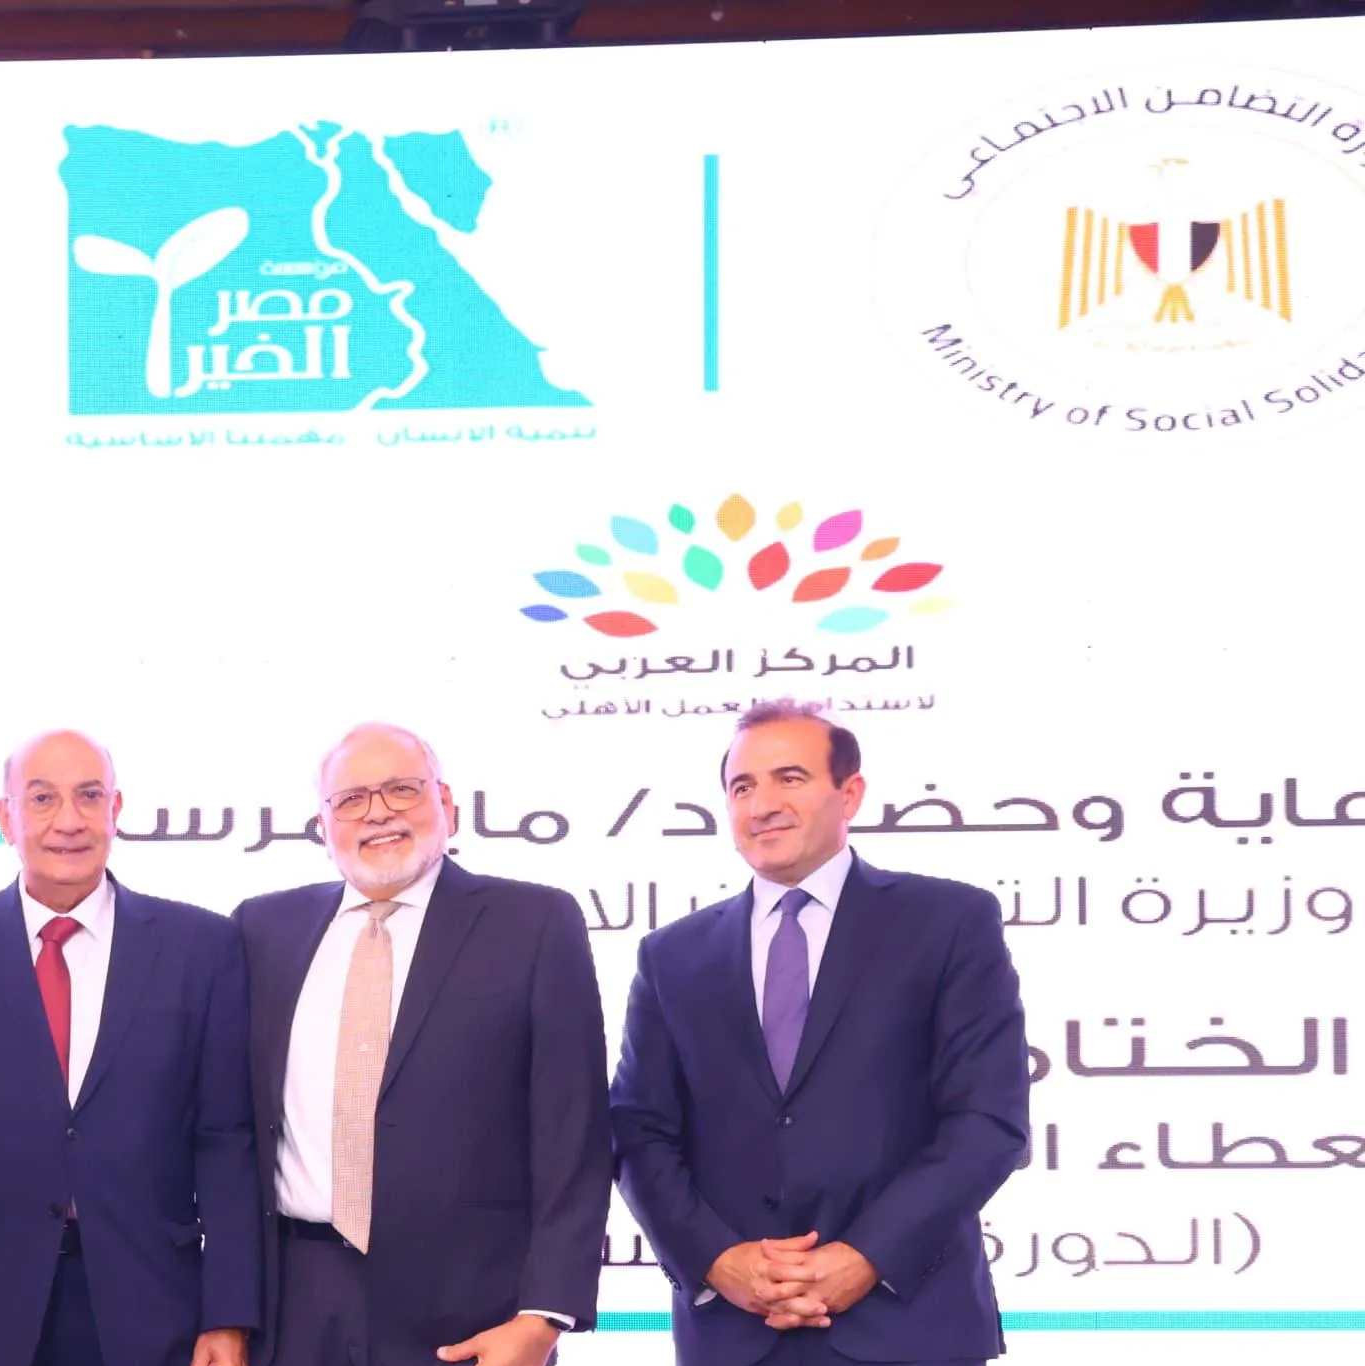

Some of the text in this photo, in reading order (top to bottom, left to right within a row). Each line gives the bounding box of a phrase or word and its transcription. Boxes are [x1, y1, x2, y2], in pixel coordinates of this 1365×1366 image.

[1145, 85, 1332, 126] التضامن
[208, 288, 353, 336] مصر
[173, 324, 352, 398] الخير
[921, 323, 1365, 432] Ministry of Social Solid
[753, 645, 914, 679] المركز
[848, 783, 1125, 842] وحض
[1162, 772, 1365, 845] عاية
[1121, 874, 1353, 936] وزيرة
[1097, 1122, 1365, 1170] عطاء
